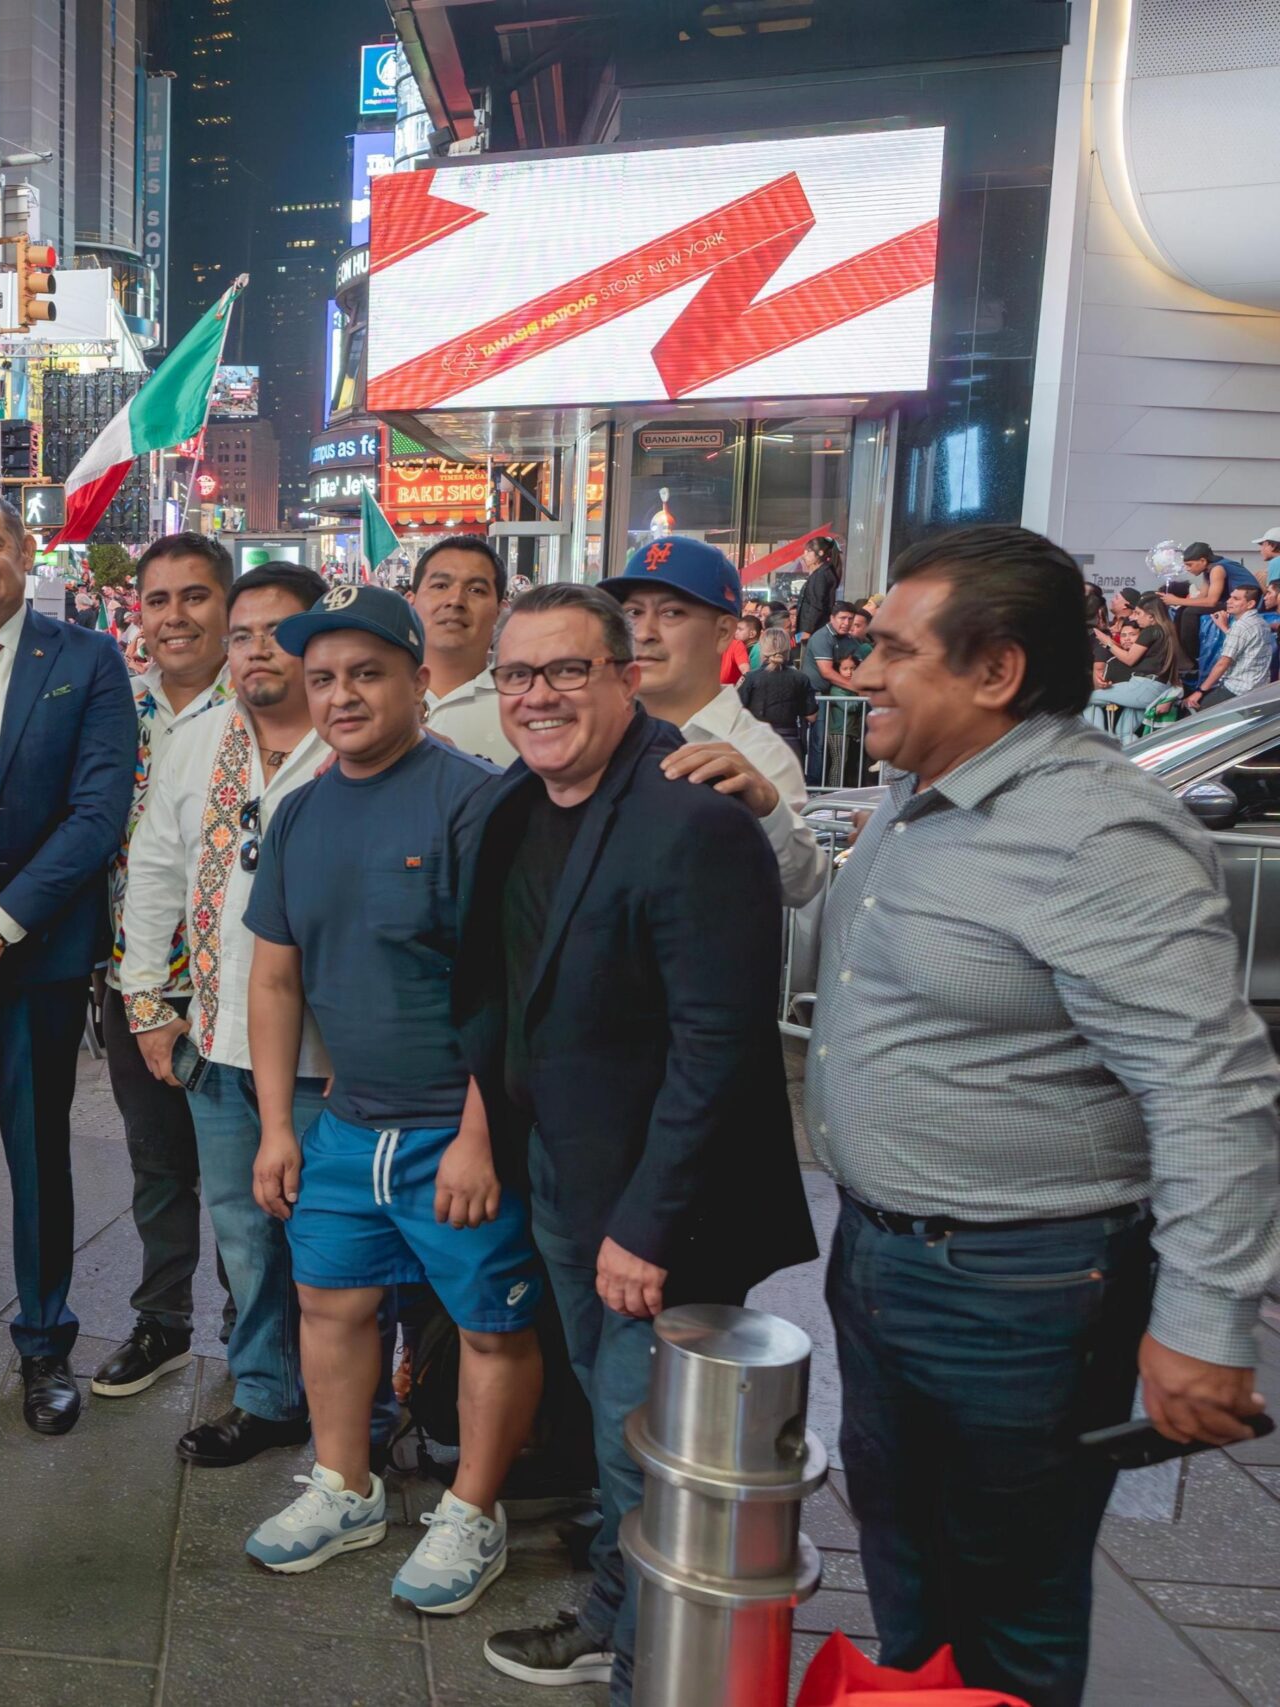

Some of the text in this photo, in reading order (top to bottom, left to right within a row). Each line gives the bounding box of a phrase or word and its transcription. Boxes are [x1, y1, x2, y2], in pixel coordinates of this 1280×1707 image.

[145, 92, 162, 312] TIMES SQU
[541, 293, 598, 330] NATIONS
[600, 269, 646, 300] STORE
[647, 250, 682, 276] NEW
[683, 230, 727, 258] YORK
[644, 434, 718, 444] BANDAI NAMCO
[337, 441, 356, 457] as
[397, 485, 444, 504] BAKE
[1092, 573, 1136, 586] Tamares
